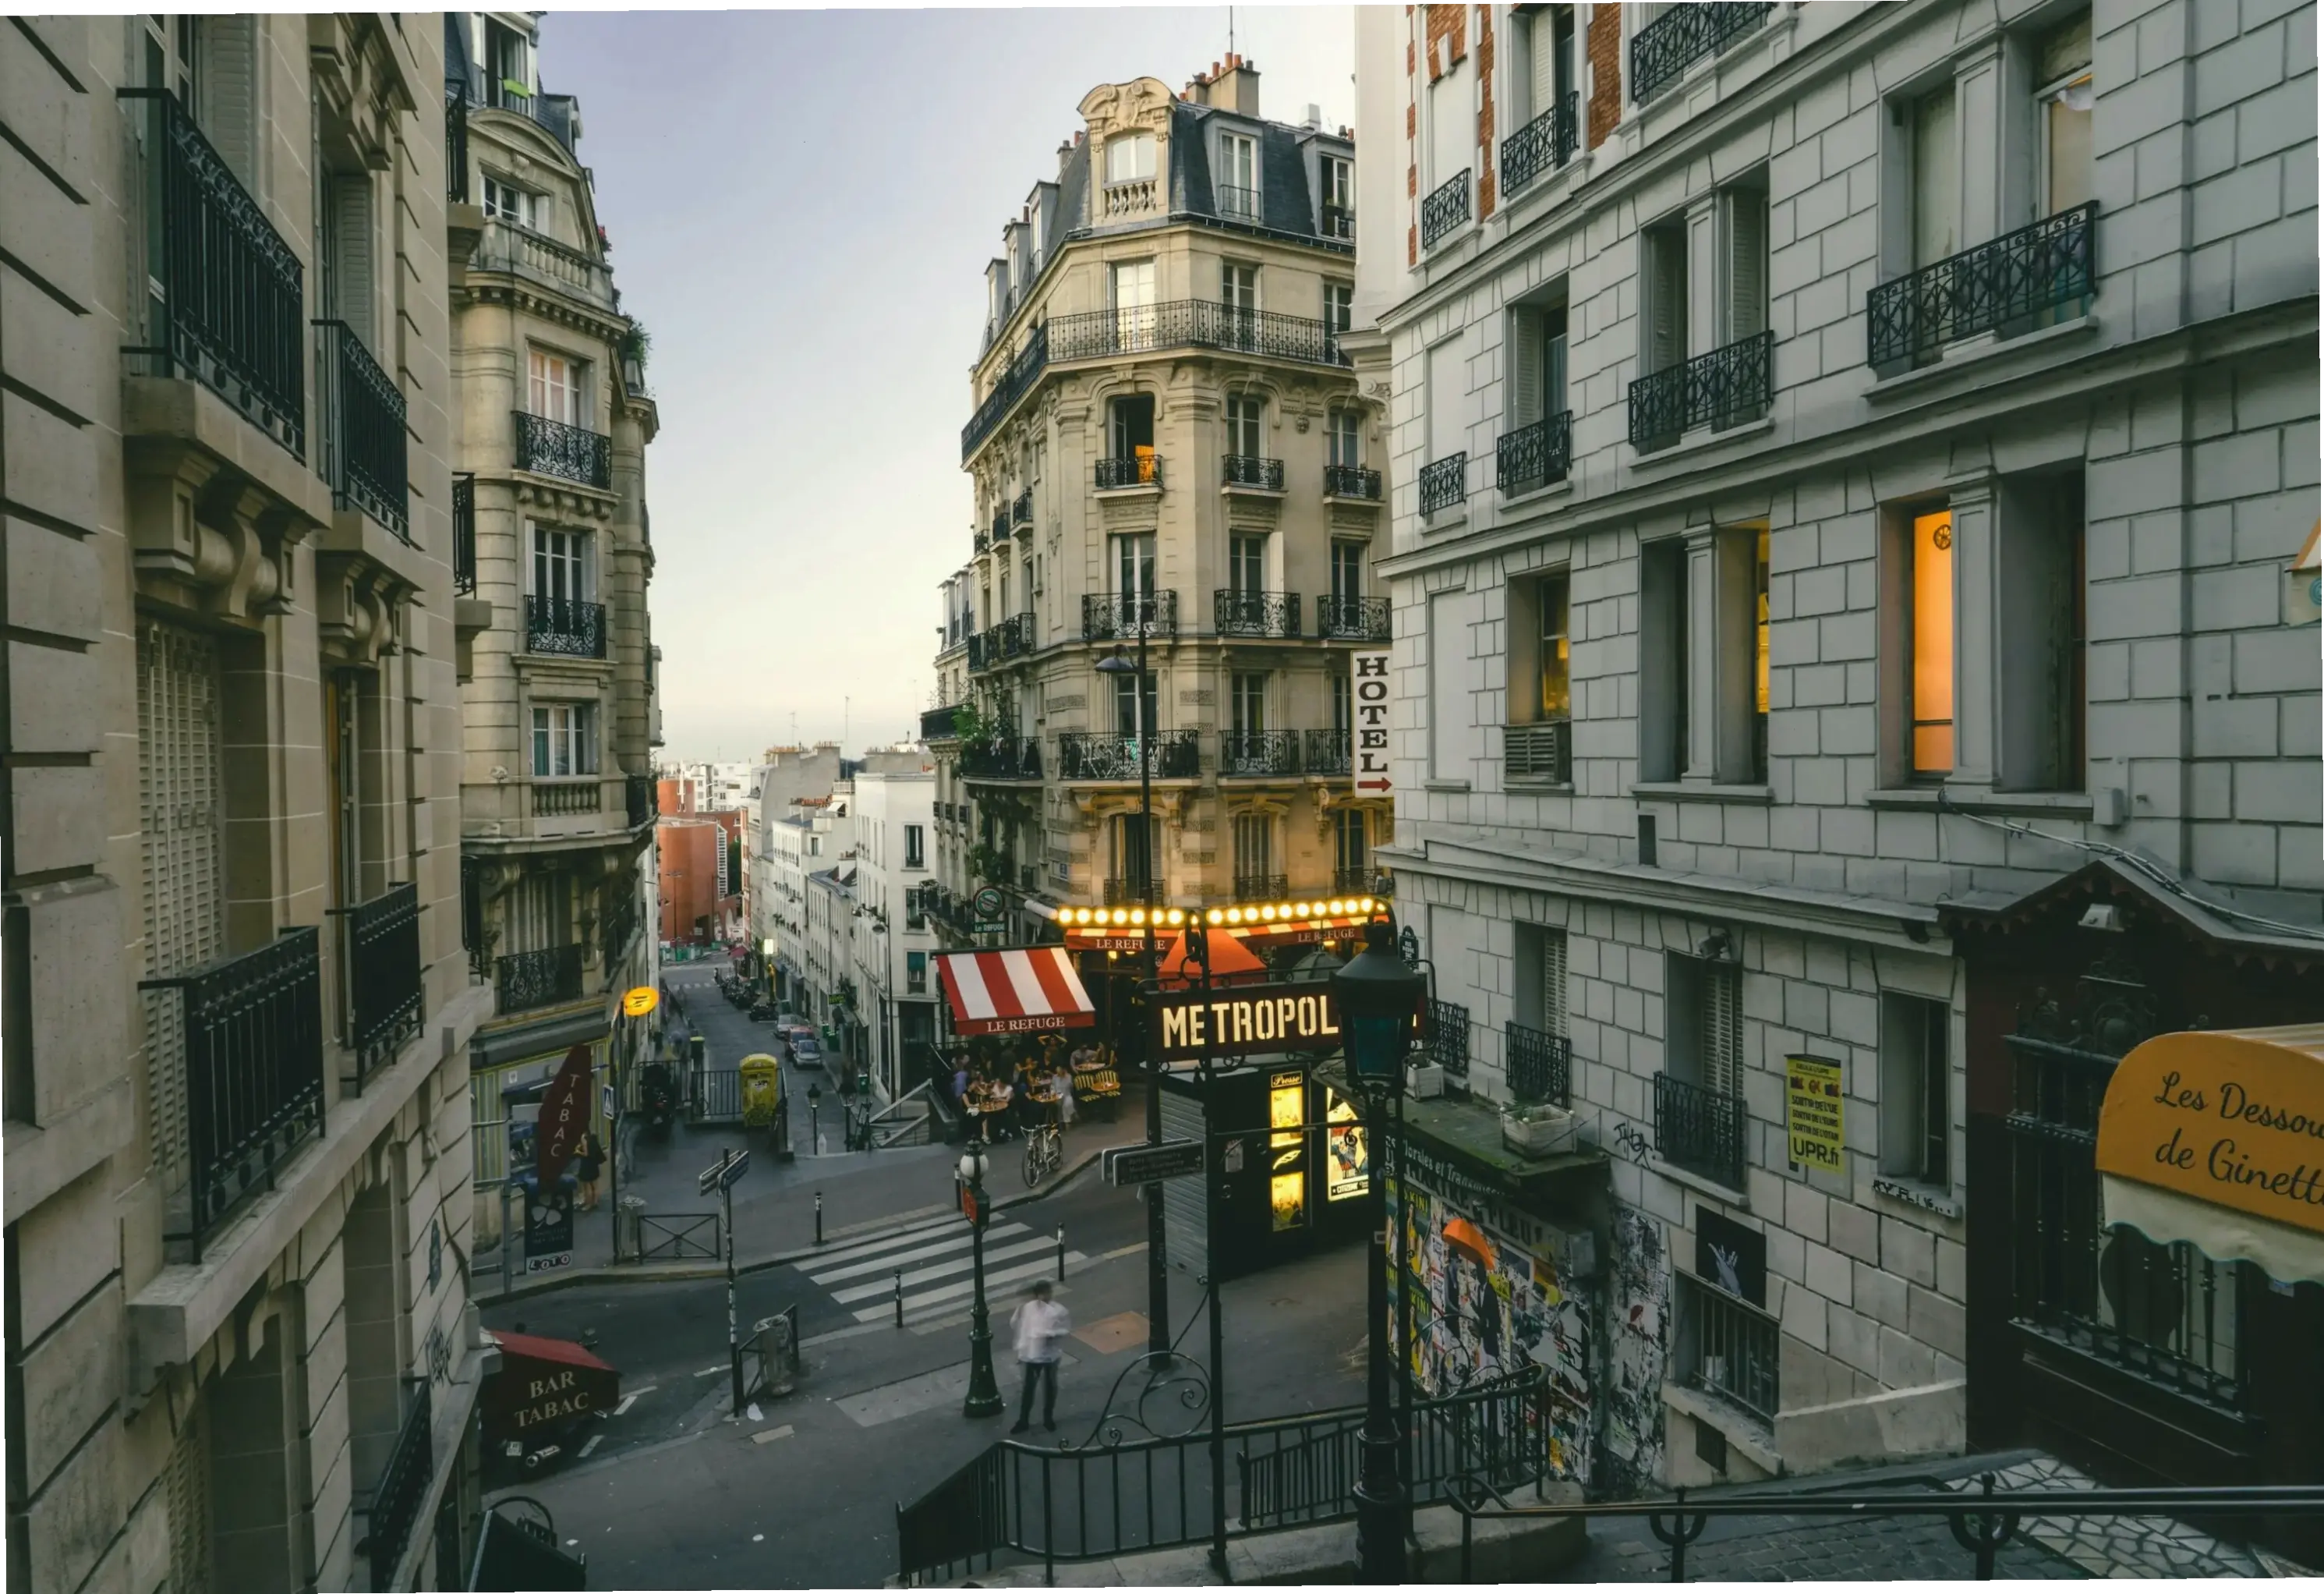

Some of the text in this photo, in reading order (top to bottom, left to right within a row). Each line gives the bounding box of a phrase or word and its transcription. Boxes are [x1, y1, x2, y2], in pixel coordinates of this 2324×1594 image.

[1357, 657, 1388, 773] HOTEL
[1096, 939, 1166, 950] LE REFUE
[1297, 932, 1311, 943] LE
[987, 1016, 1066, 1033] LE REFUGE
[1162, 995, 1339, 1048] METROPOL
[550, 1074, 581, 1157] TABAC
[2154, 1072, 2323, 1139] Les Dessou
[1403, 1138, 1433, 1171] lorales
[2156, 1128, 2323, 1205] de Ginett
[529, 1254, 571, 1271] LOTO
[529, 1371, 575, 1399] BAR
[514, 1392, 589, 1427] TABAC
